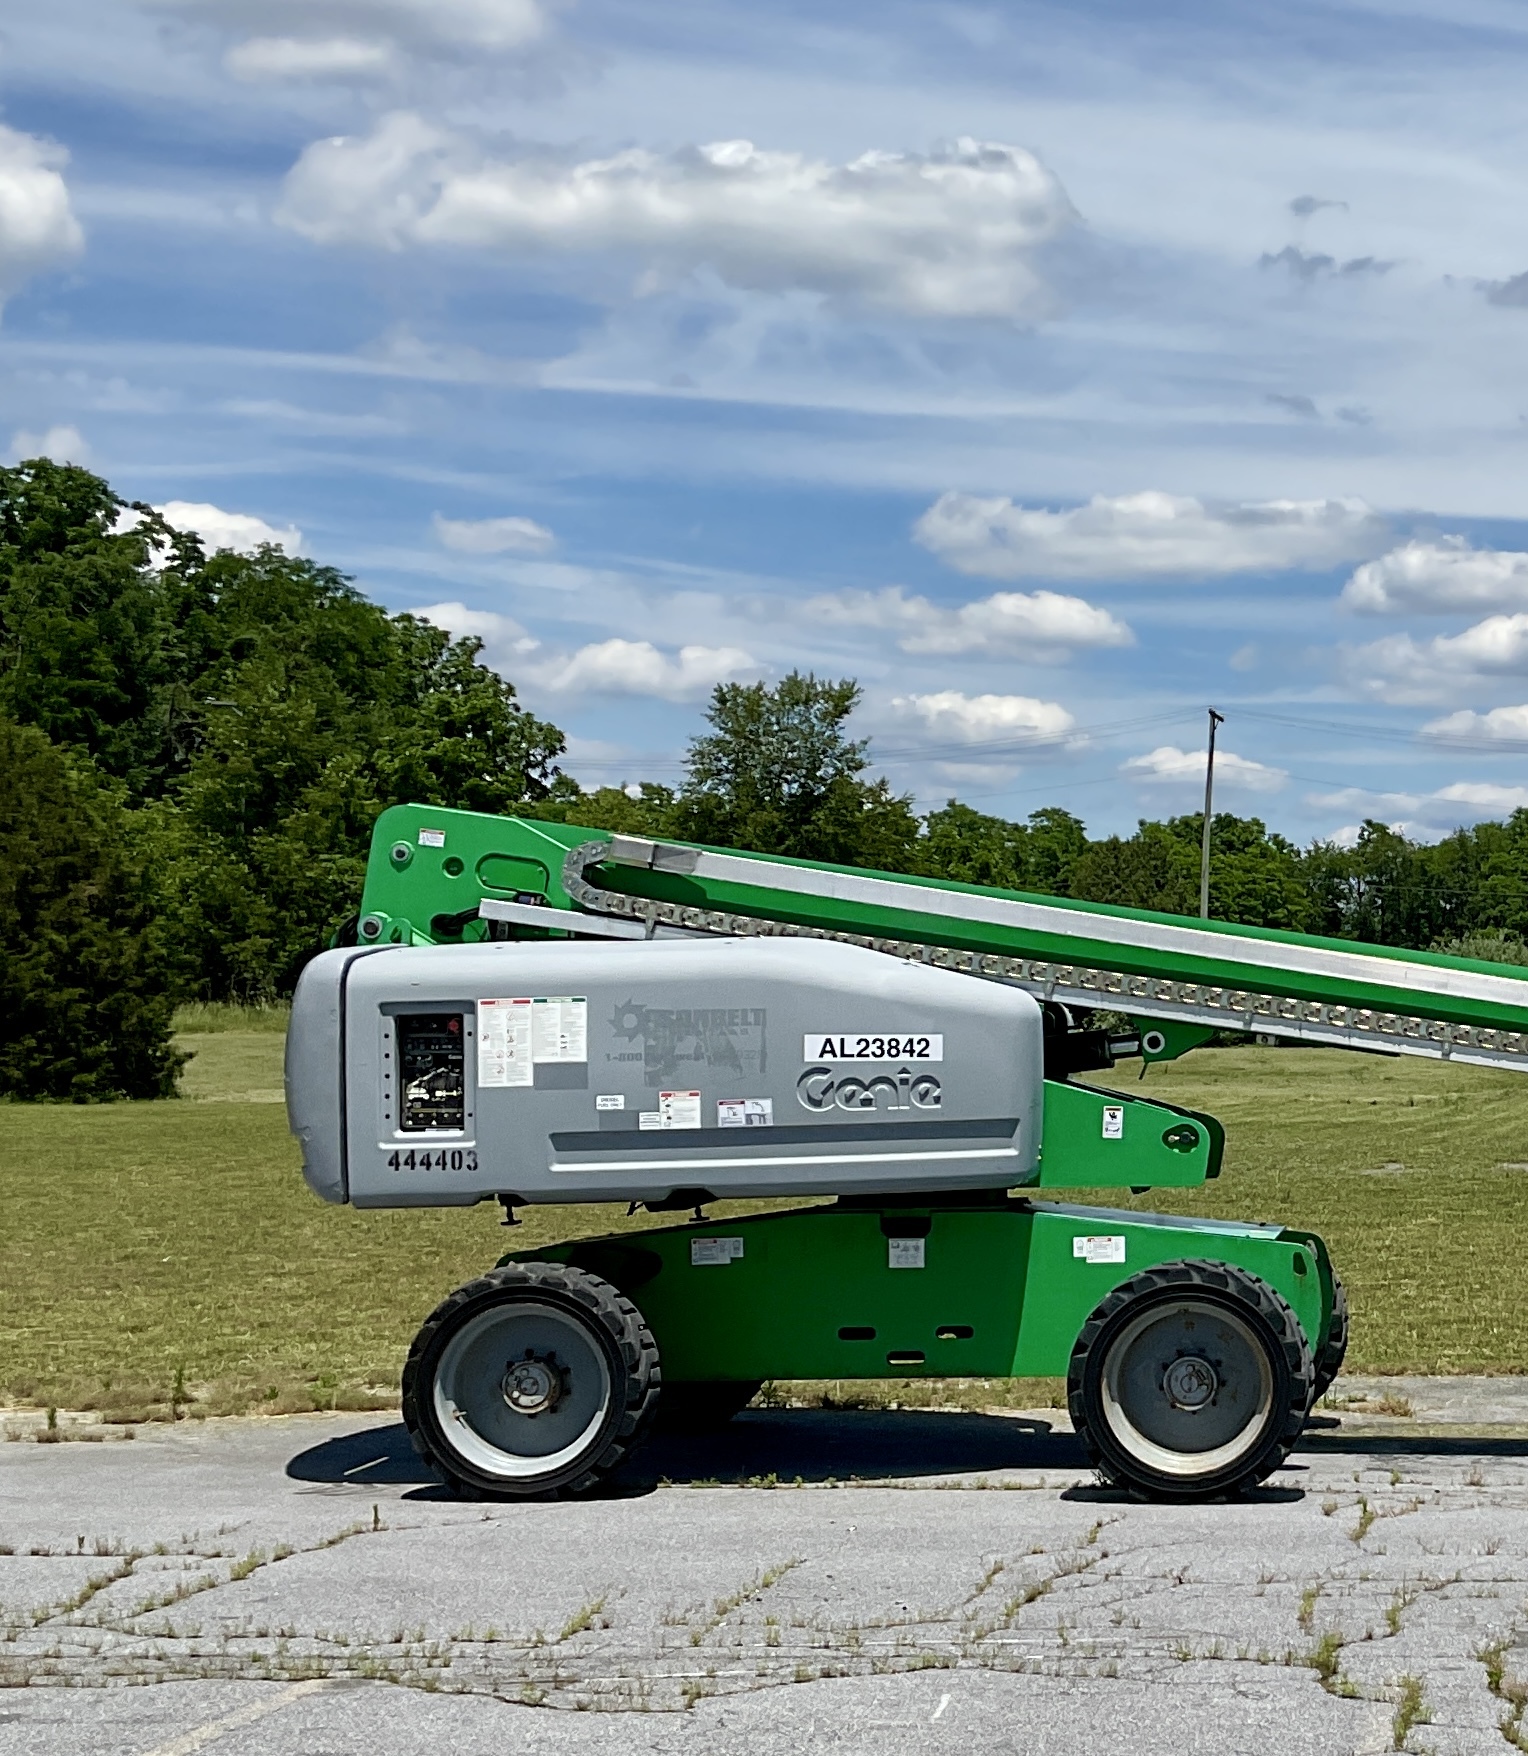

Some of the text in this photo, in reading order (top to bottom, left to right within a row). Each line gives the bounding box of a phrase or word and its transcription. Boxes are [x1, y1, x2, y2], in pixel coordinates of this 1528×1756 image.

[818, 1037, 930, 1058] AL23842
[797, 1066, 941, 1112] Genie
[388, 1149, 478, 1172] 444403
